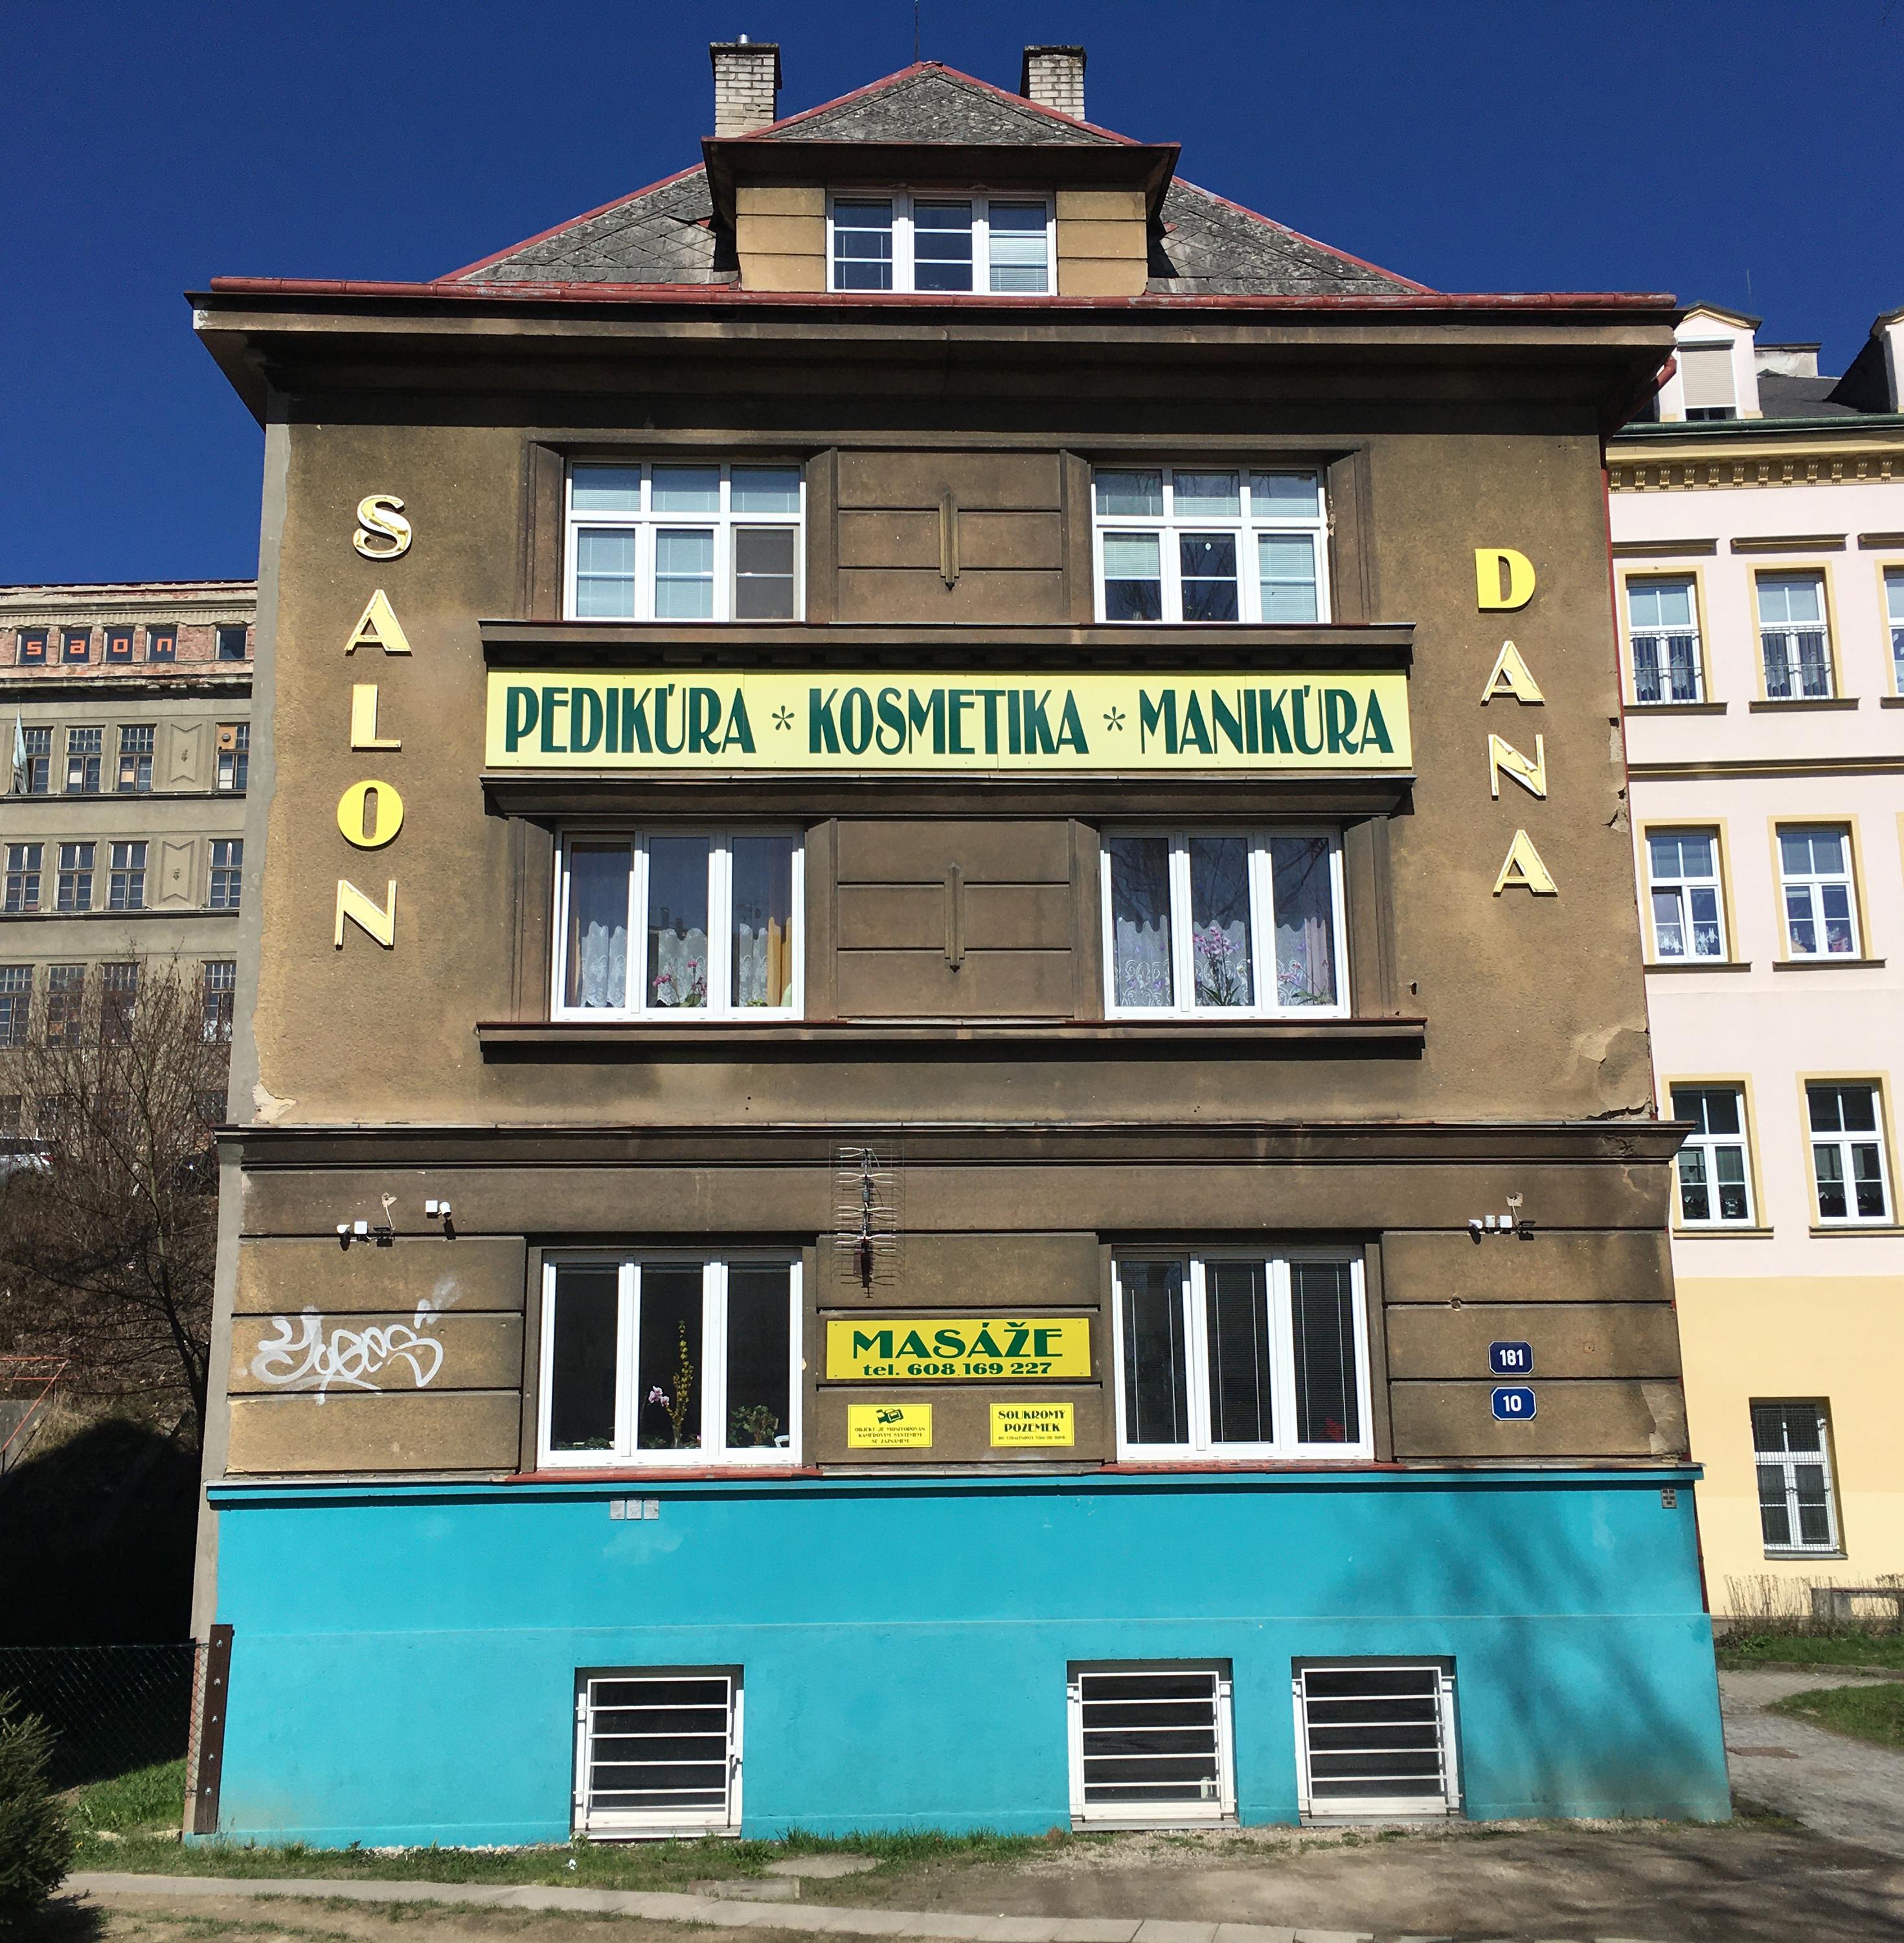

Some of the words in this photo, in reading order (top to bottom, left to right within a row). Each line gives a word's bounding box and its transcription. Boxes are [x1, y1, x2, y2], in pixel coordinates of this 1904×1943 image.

[334, 494, 413, 948] SALON
[506, 684, 756, 754] PEDIKÚRA
[810, 687, 1089, 755] KOSMETIKA
[1140, 685, 1394, 755] MANIKÚRA
[1475, 548, 1558, 893] DANA
[854, 1322, 1063, 1359] MASÁŽE
[863, 1364, 899, 1376] tel.
[908, 1363, 955, 1375] 608
[963, 1363, 1003, 1374] 169
[1010, 1363, 1052, 1374] 227
[1500, 1350, 1523, 1365] 181
[1503, 1396, 1521, 1411] 10
[1004, 1423, 1060, 1432] POZEMEK
